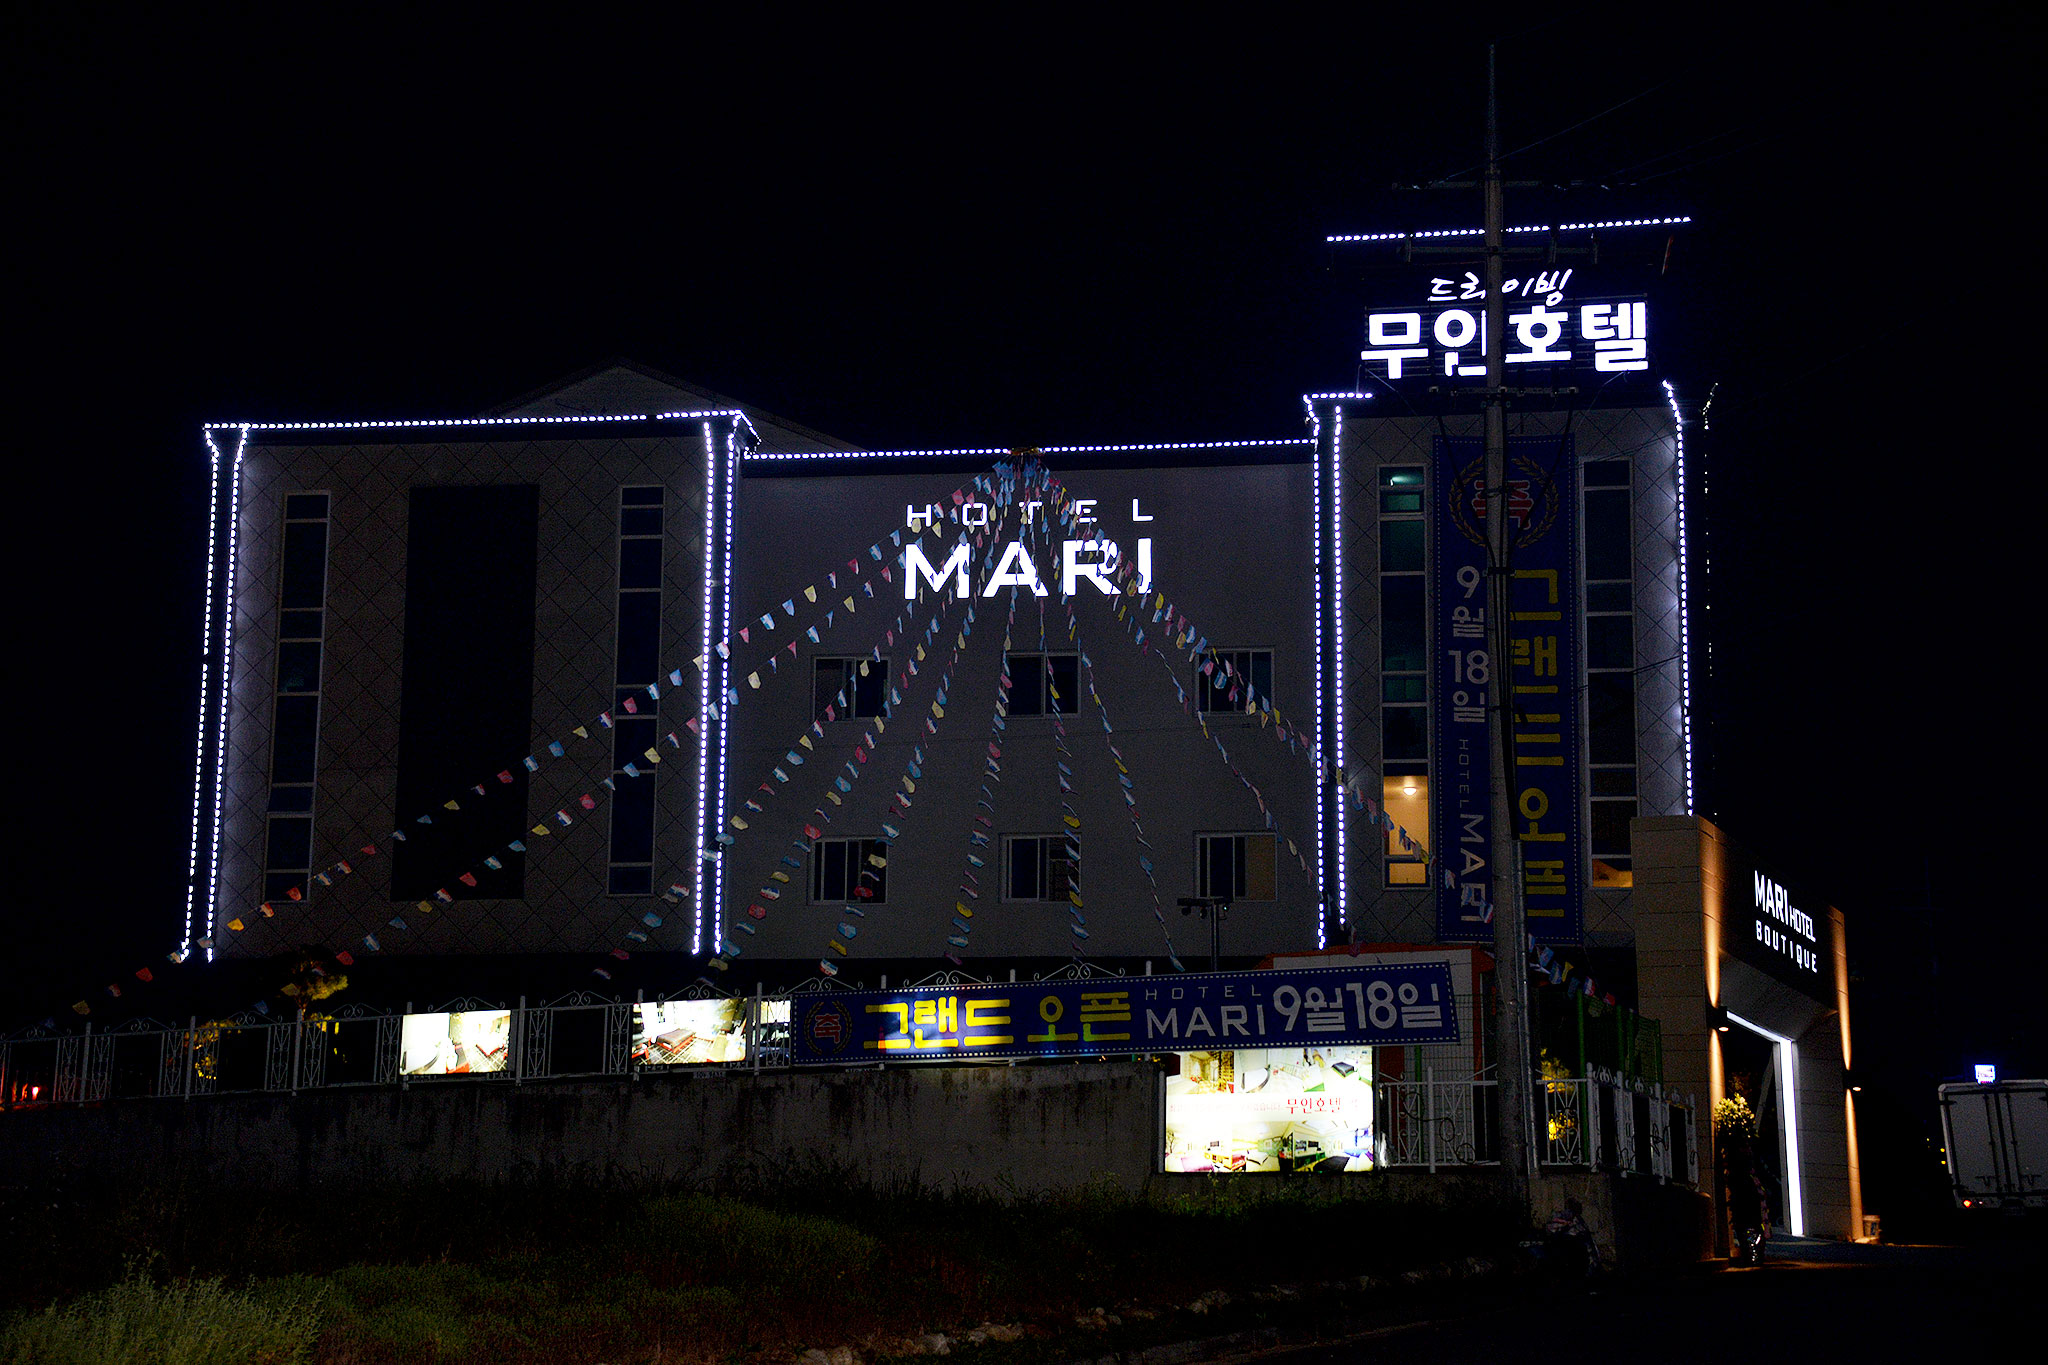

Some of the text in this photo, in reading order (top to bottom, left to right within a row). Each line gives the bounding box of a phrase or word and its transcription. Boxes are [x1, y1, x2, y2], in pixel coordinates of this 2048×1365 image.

[1361, 302, 1649, 379] 무인호텔
[906, 498, 1154, 528] HOTEL
[904, 537, 1153, 600] MARI
[1457, 738, 1487, 922] HOTEL MARI
[1754, 869, 1816, 943] MARI HOTEL
[1756, 919, 1818, 973] BOUTIQUE
[862, 991, 1132, 1049] 그랜드 오픈
[1145, 984, 1262, 1001] HOTEL
[1145, 1003, 1267, 1039] MARI
